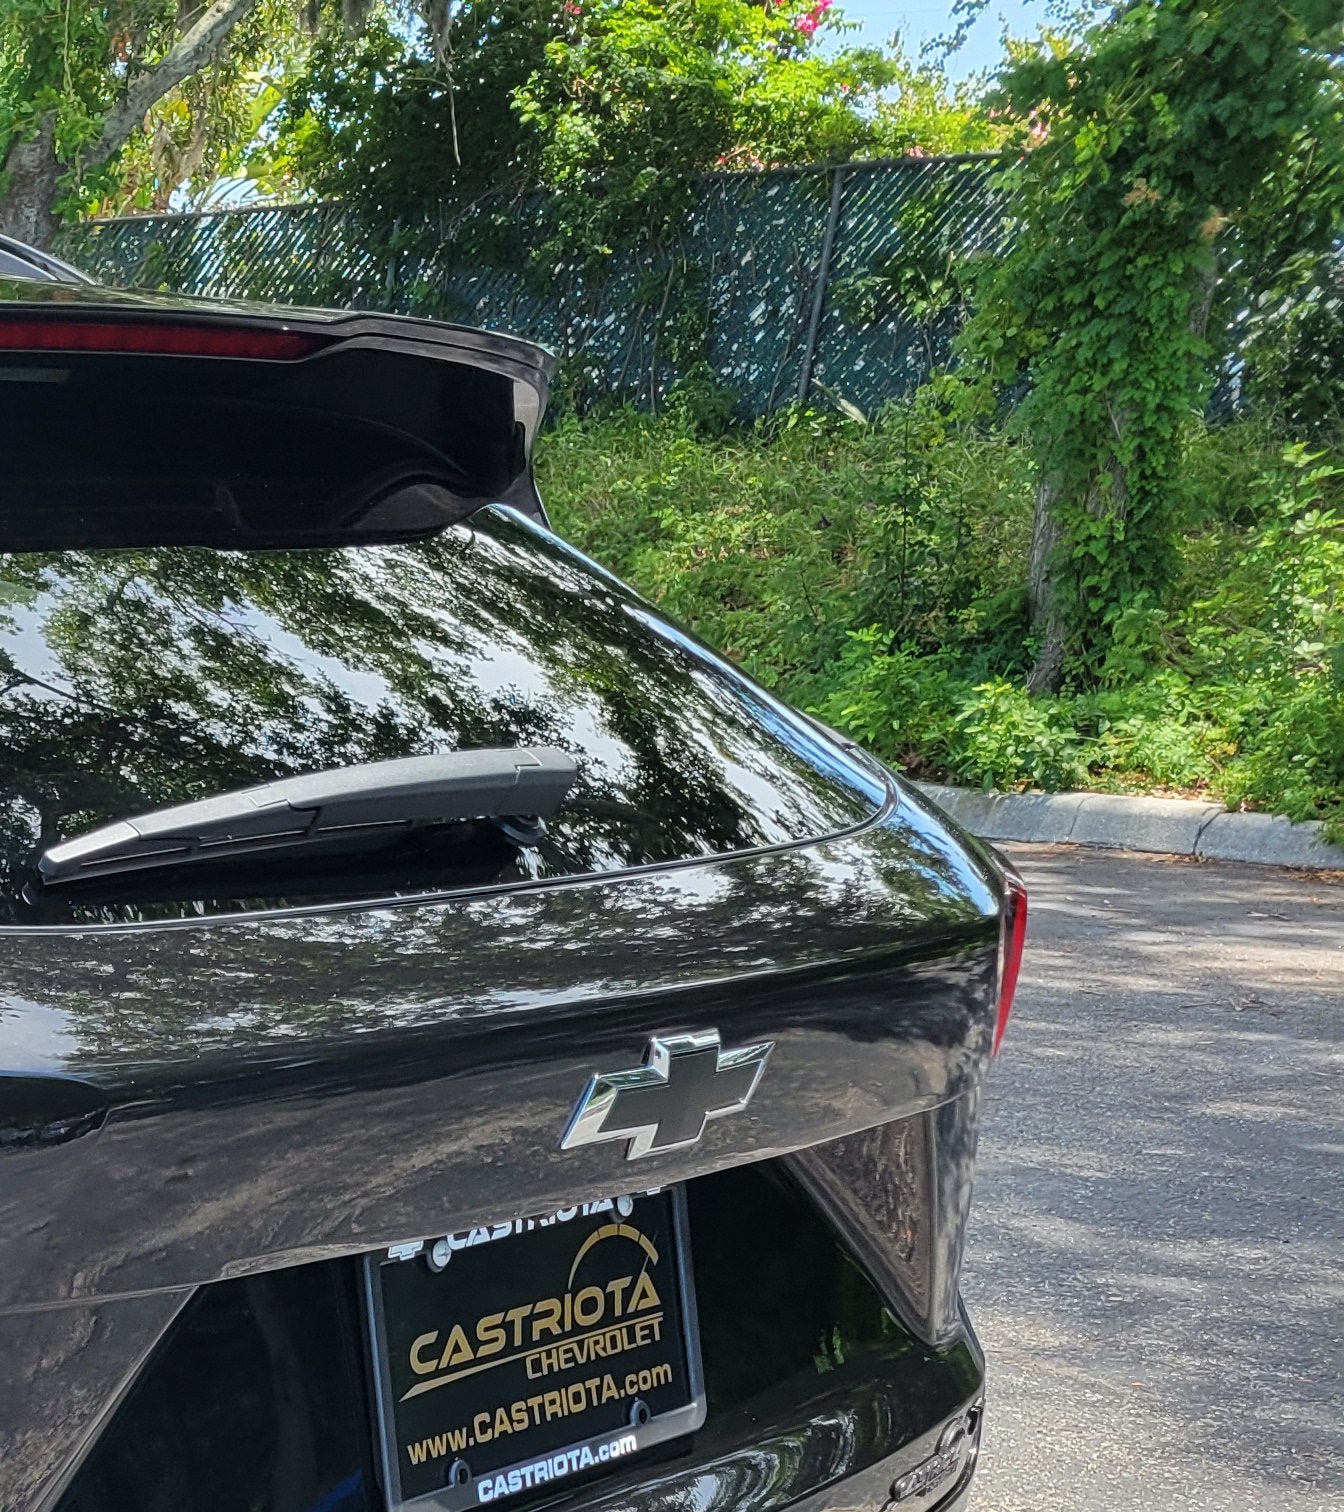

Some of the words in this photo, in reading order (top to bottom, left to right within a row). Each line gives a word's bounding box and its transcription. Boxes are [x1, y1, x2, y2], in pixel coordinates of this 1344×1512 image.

[410, 1271, 662, 1375] CASTRIOTA
[526, 1318, 664, 1380] CHEVROLET
[407, 1363, 673, 1465] www.CASTRIOTA.com
[478, 1434, 637, 1502] CASTRIOTA.com
